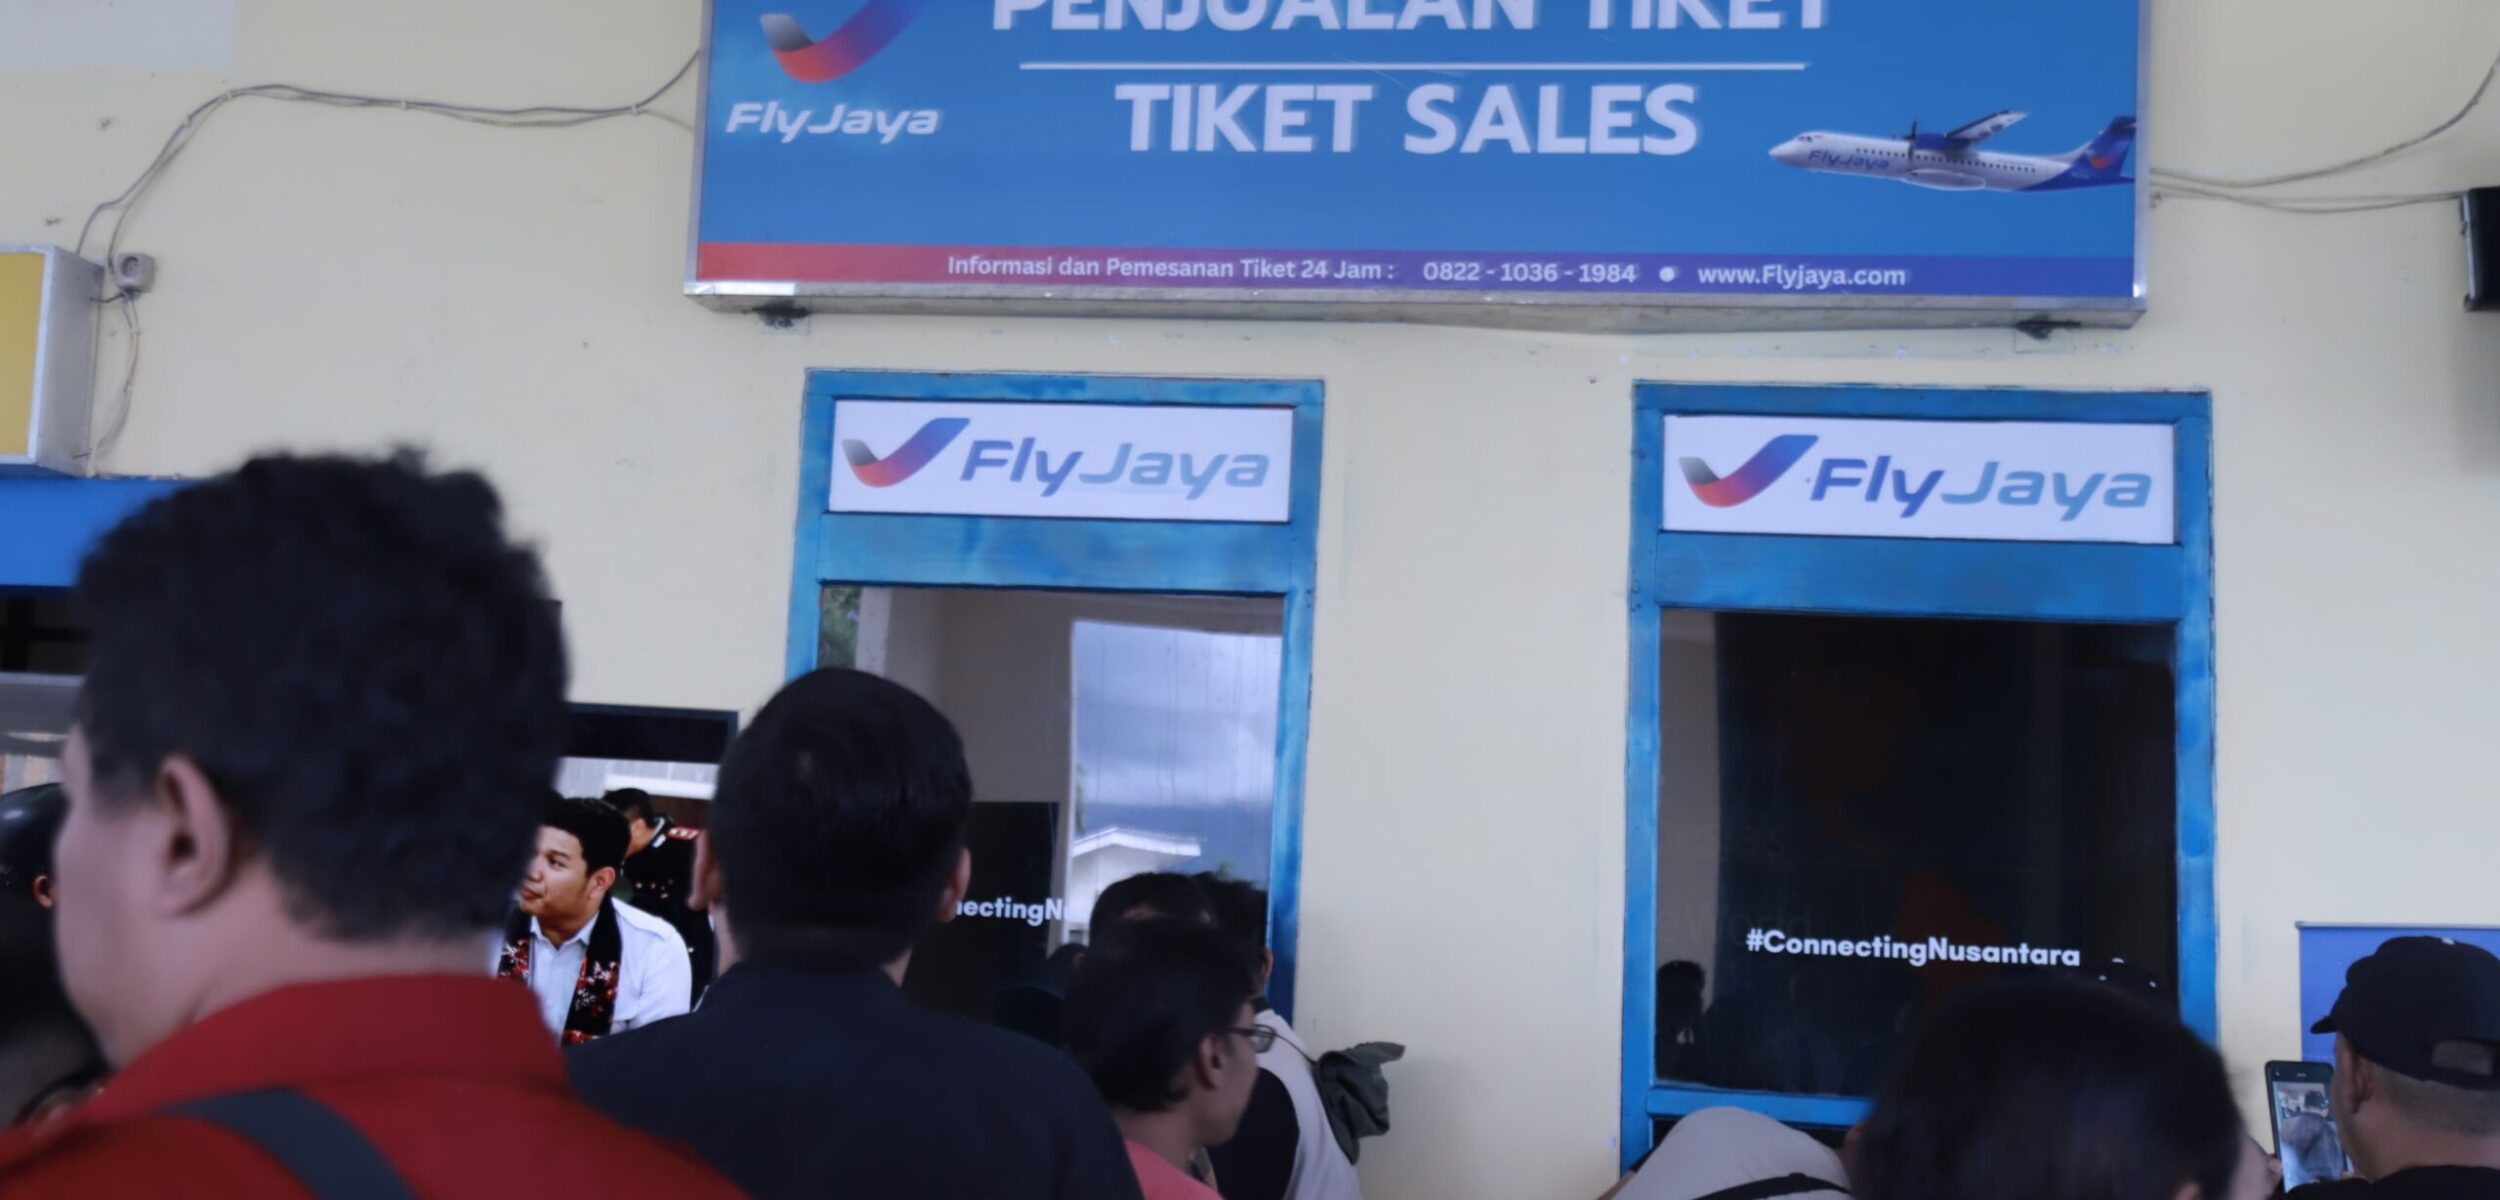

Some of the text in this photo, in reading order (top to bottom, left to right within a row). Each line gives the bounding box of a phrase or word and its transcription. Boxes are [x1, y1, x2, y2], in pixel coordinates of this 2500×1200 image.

[726, 101, 940, 144] FlyJaya
[1115, 83, 1699, 155] TIKET SALES
[949, 255, 1053, 276] Informasi
[1059, 256, 1100, 276] dan
[1106, 257, 1234, 278] Pemesanan
[1239, 259, 1296, 279] Tiket
[1301, 260, 1329, 279] 24
[1423, 261, 1481, 281] 0822
[1500, 262, 1559, 282] 1036
[1579, 263, 1637, 283] 1984
[1697, 263, 1907, 290] www.Flyjaya.com
[960, 438, 1271, 500] FlyJaya
[1811, 455, 2153, 521] FlyJaya
[1746, 928, 2080, 967] #ConnectingNusantara
